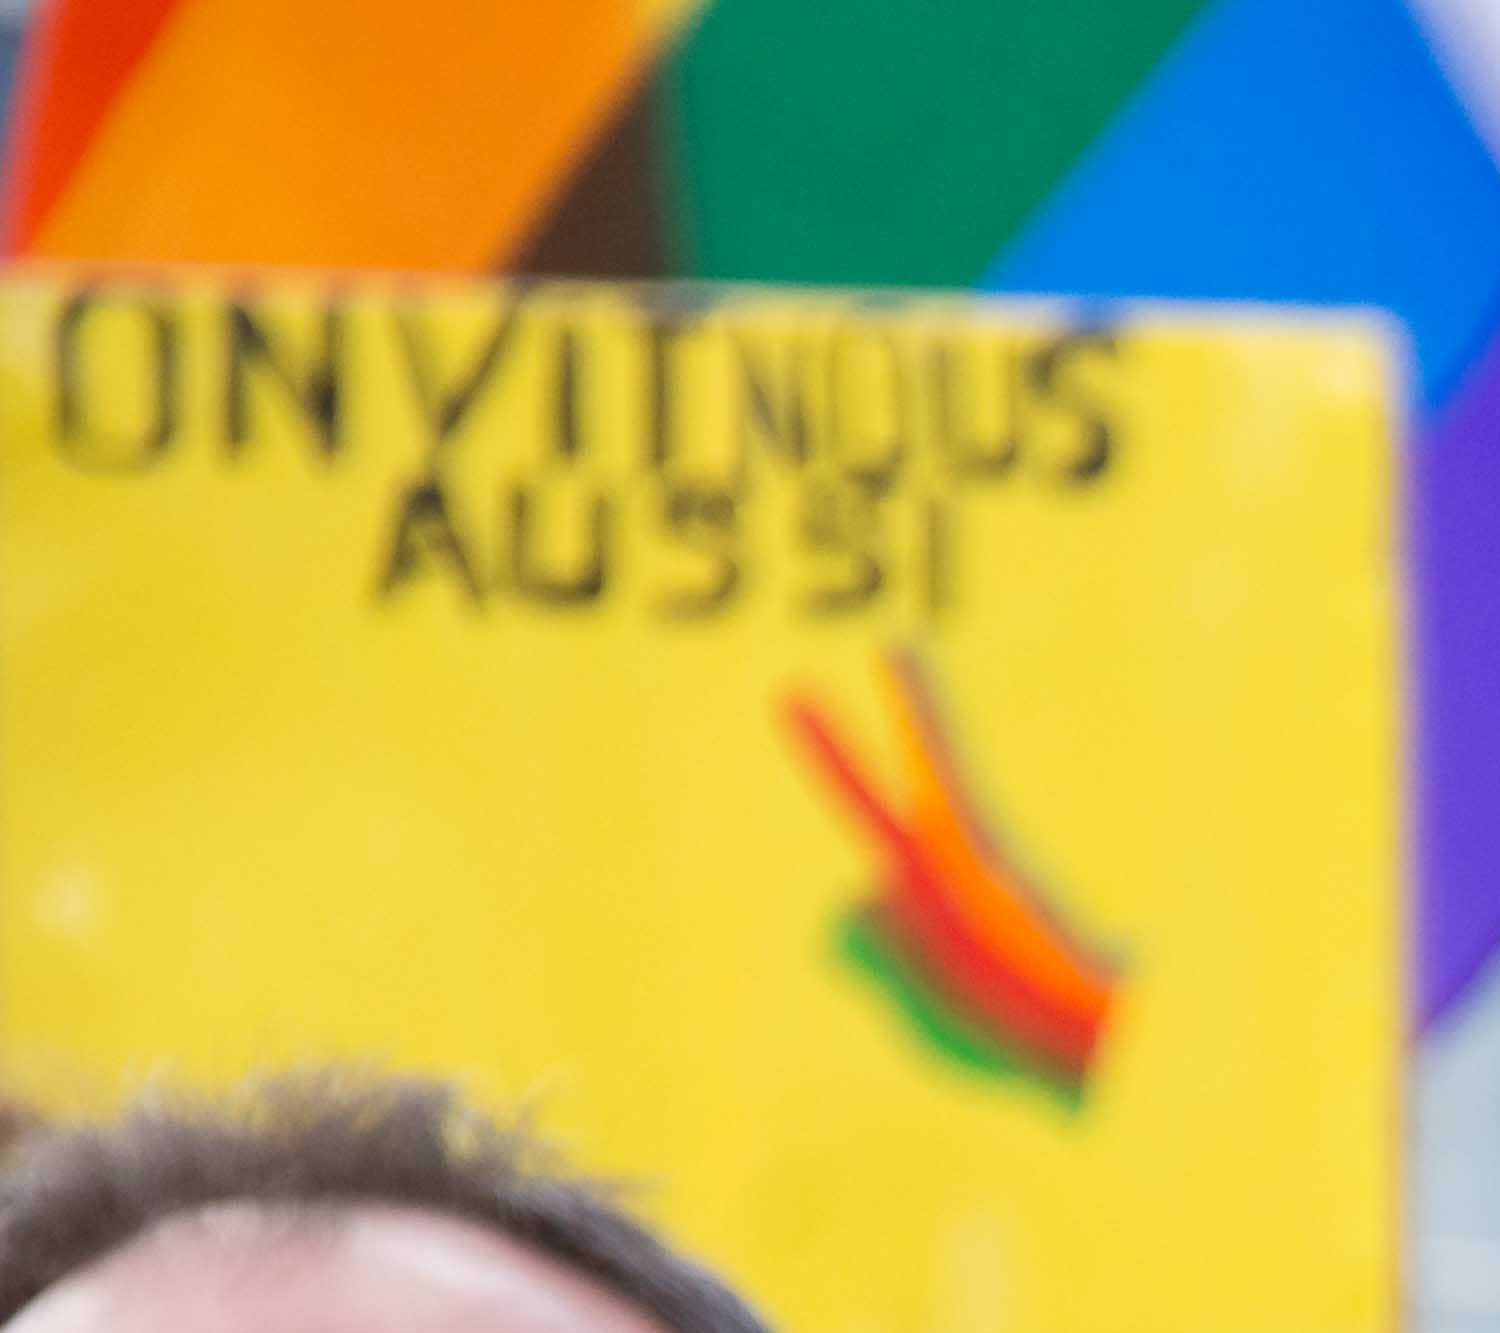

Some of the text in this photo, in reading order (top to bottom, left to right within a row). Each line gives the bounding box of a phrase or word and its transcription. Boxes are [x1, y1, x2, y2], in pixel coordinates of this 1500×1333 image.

[48, 278, 1122, 488] ON VIT NOUS
[372, 474, 958, 612] AUSSI
